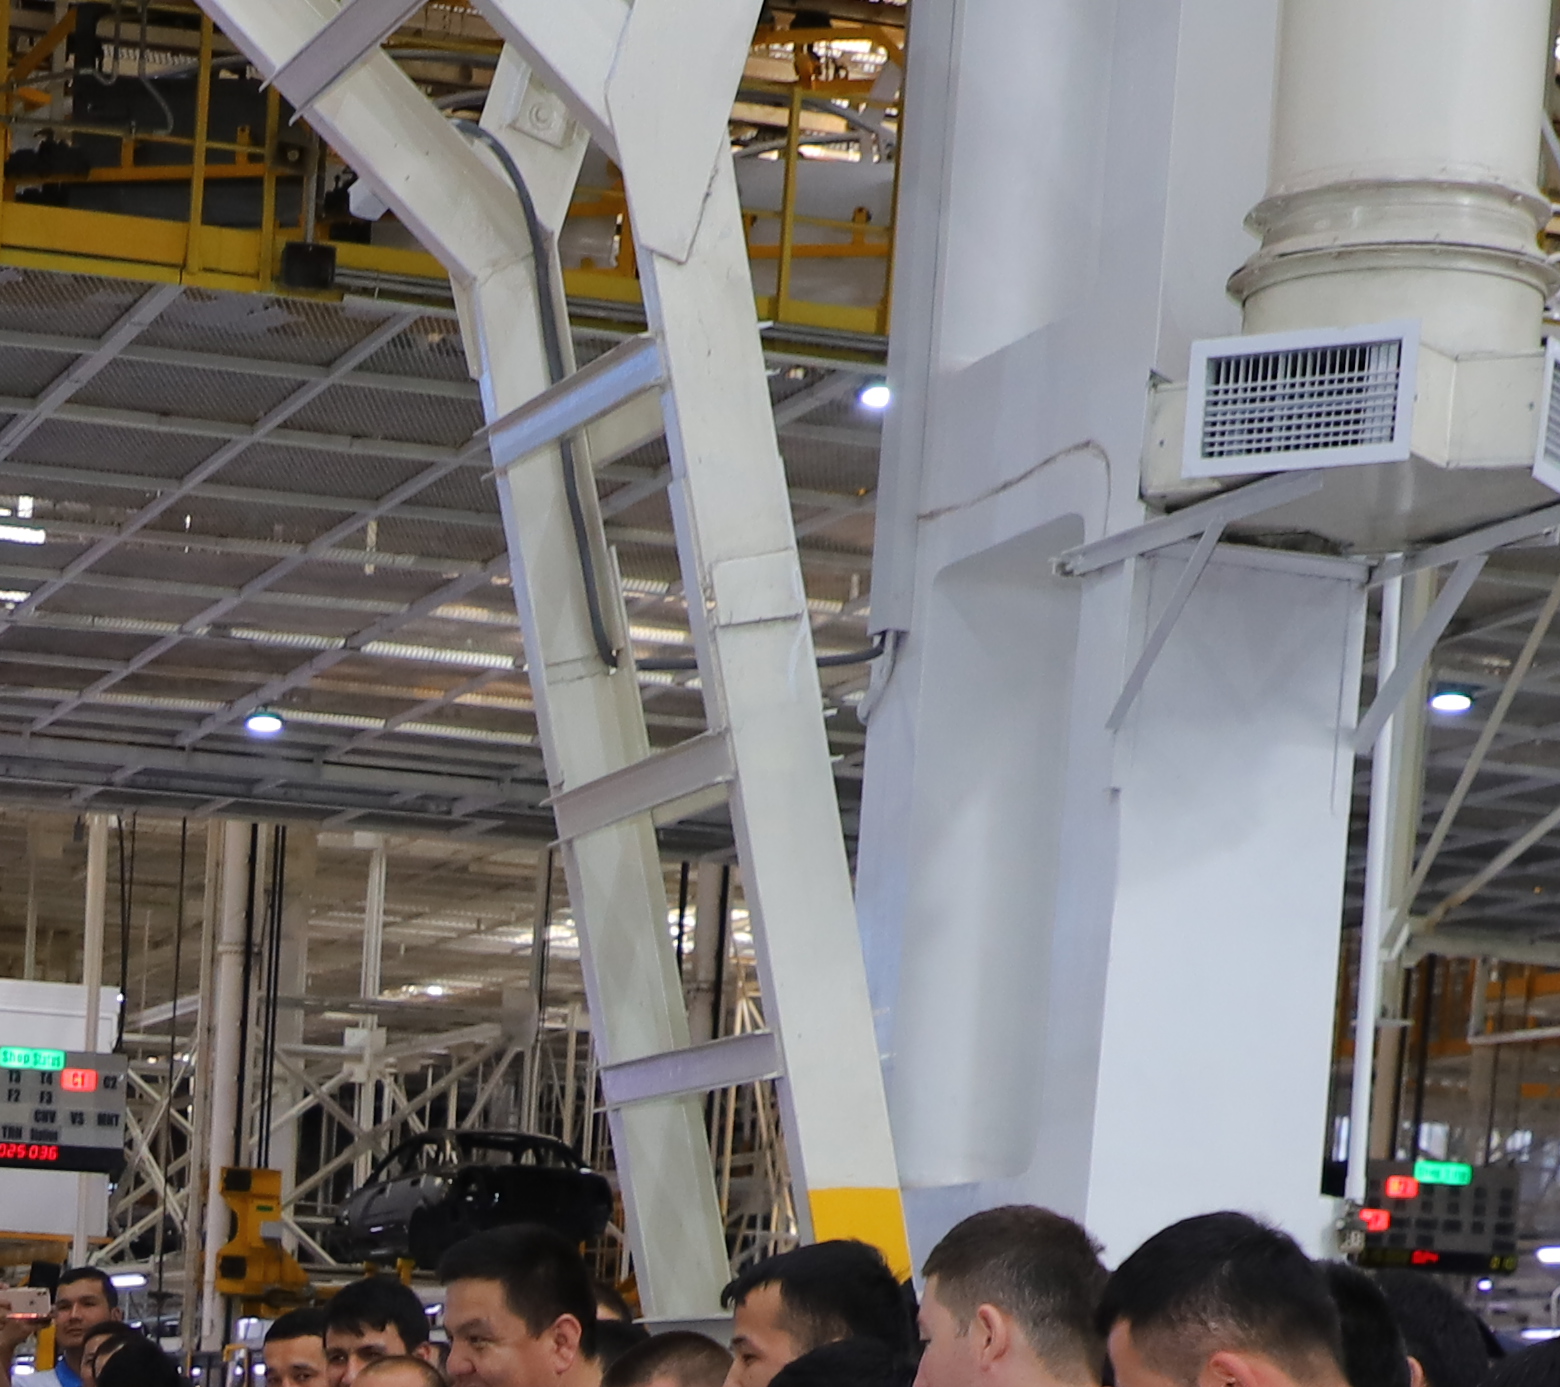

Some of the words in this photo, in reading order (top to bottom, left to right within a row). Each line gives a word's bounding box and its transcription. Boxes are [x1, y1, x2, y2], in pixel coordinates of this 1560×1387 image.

[40, 1072, 53, 1086] T4
[7, 1089, 21, 1102] F2
[40, 1091, 53, 1104] F3
